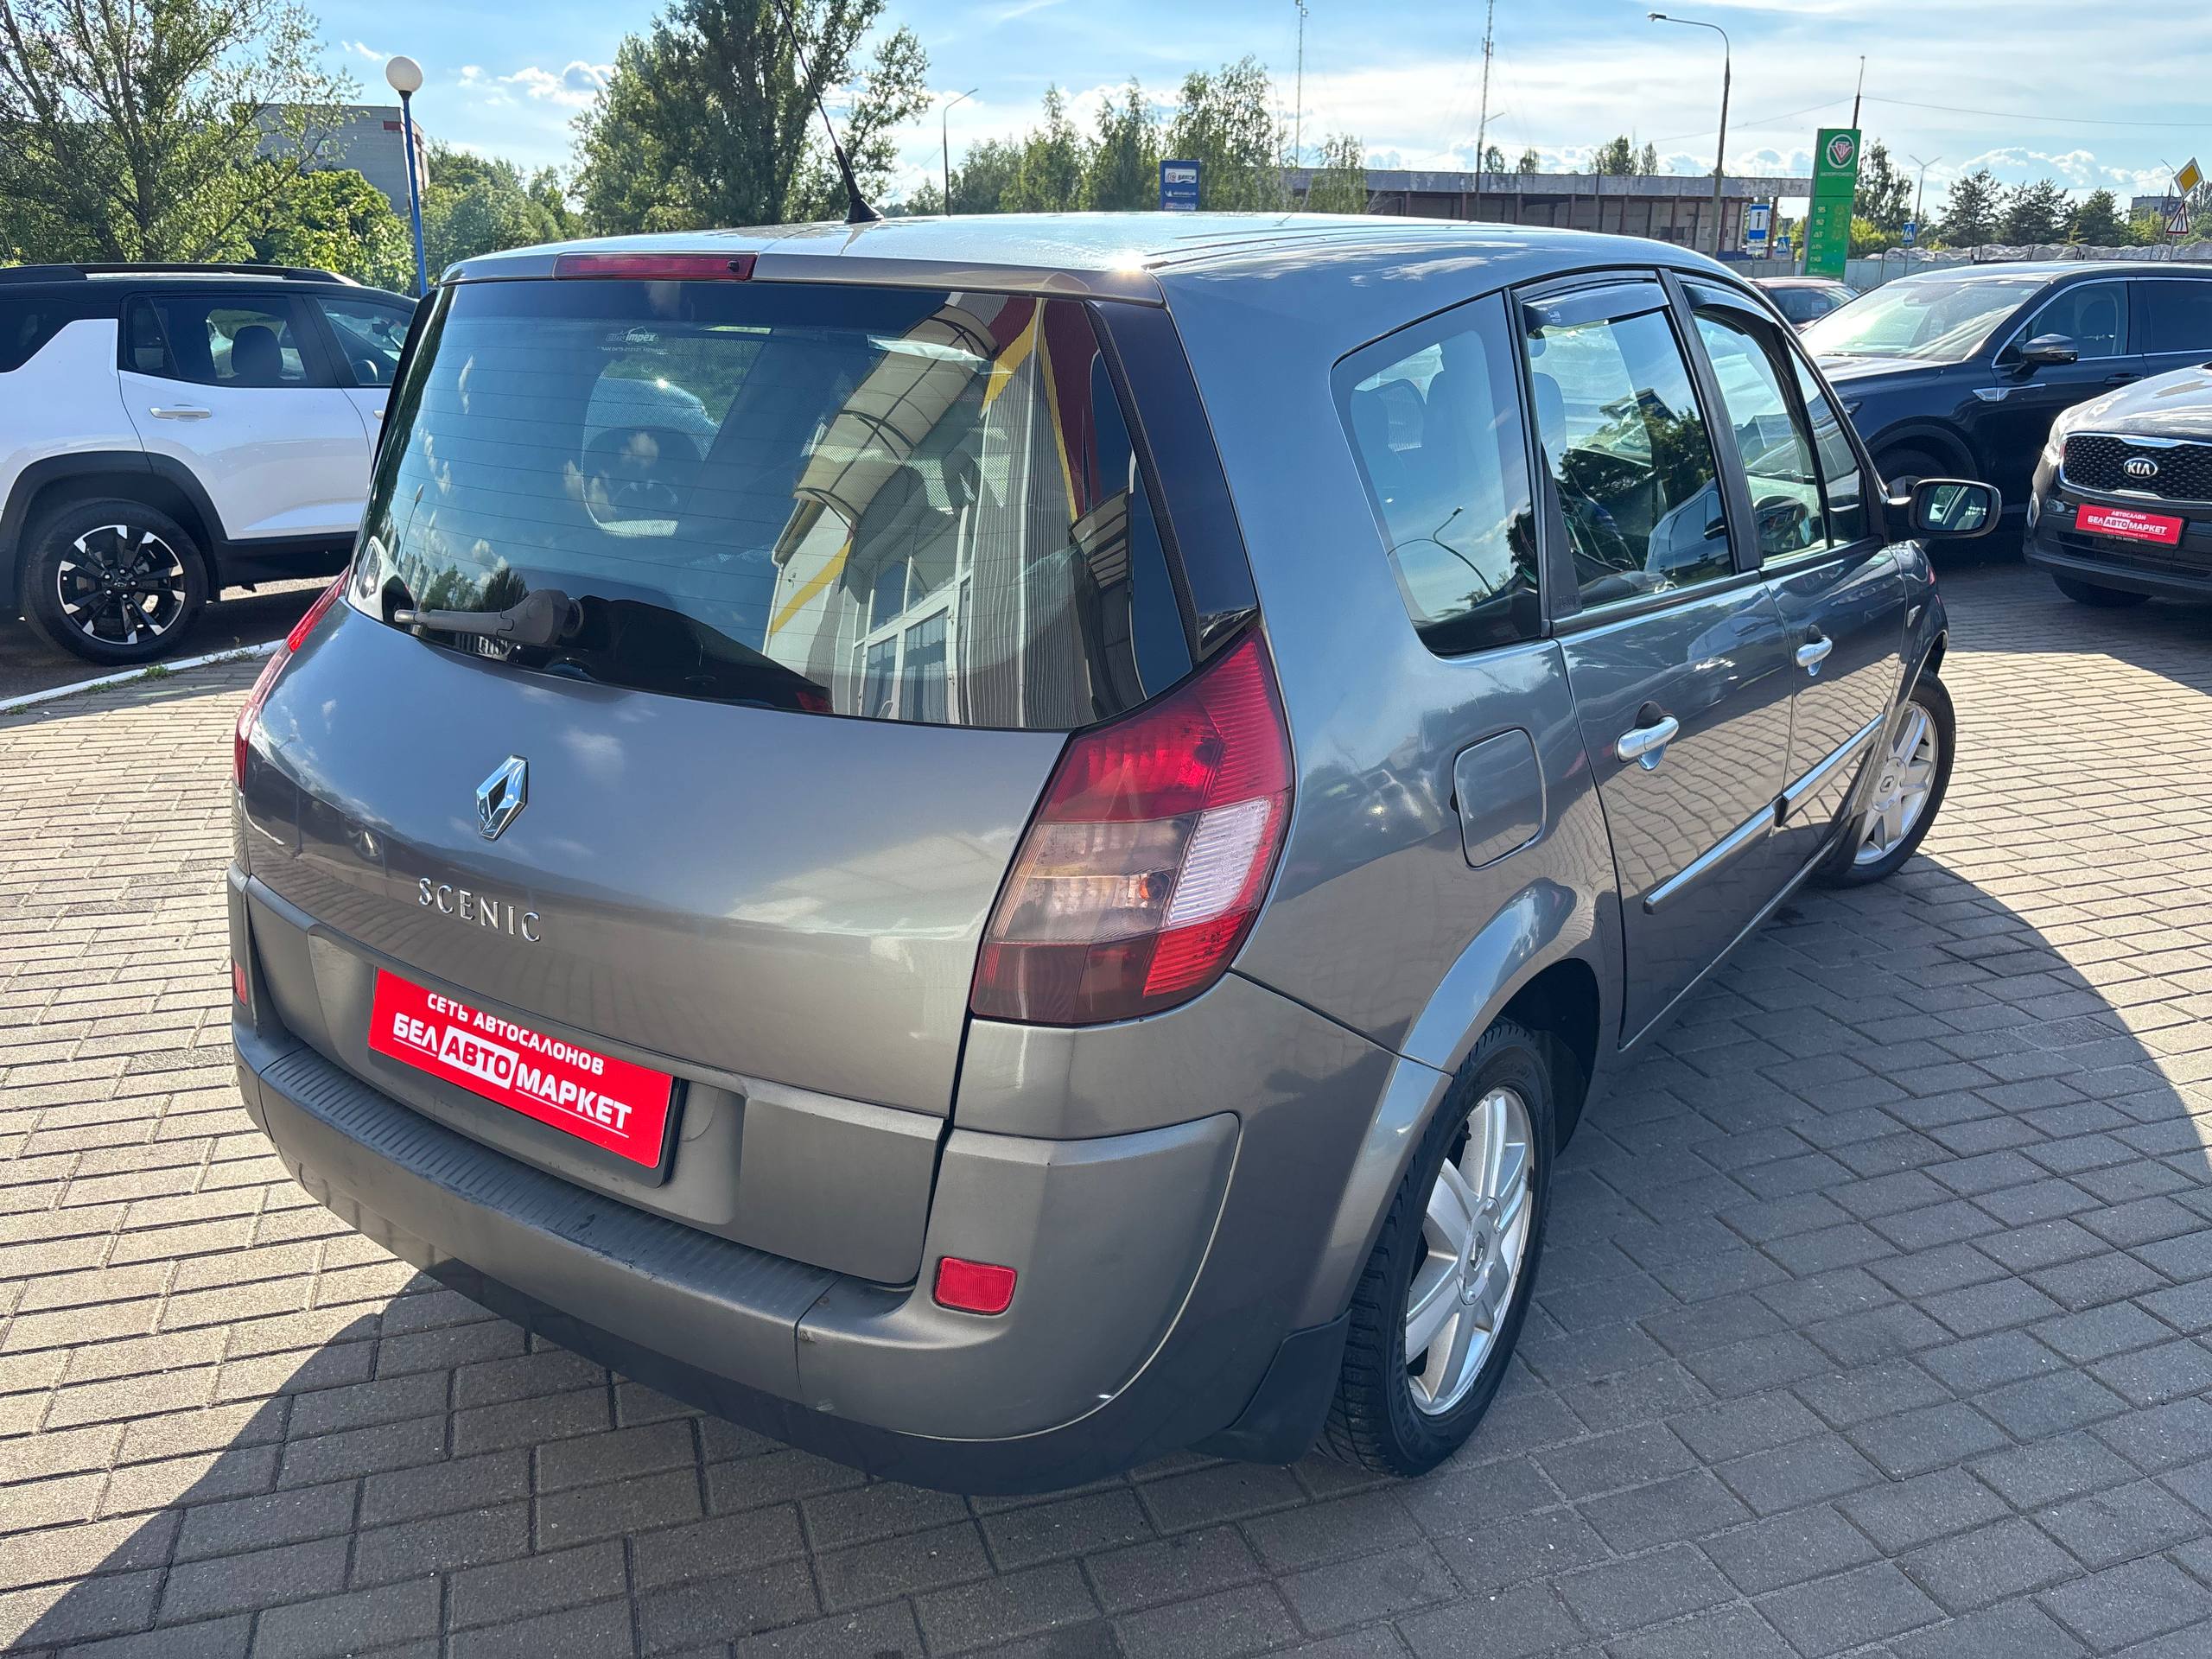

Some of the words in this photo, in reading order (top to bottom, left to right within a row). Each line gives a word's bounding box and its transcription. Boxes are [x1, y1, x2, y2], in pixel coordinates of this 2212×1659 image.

[2126, 461, 2151, 475] KIA
[2110, 511, 2147, 521] АВТОСАЛОН
[418, 877, 542, 943] SCENIC
[427, 993, 468, 1022] СЕТЬ
[472, 1011, 605, 1076] АВТОСАЛОНОВ
